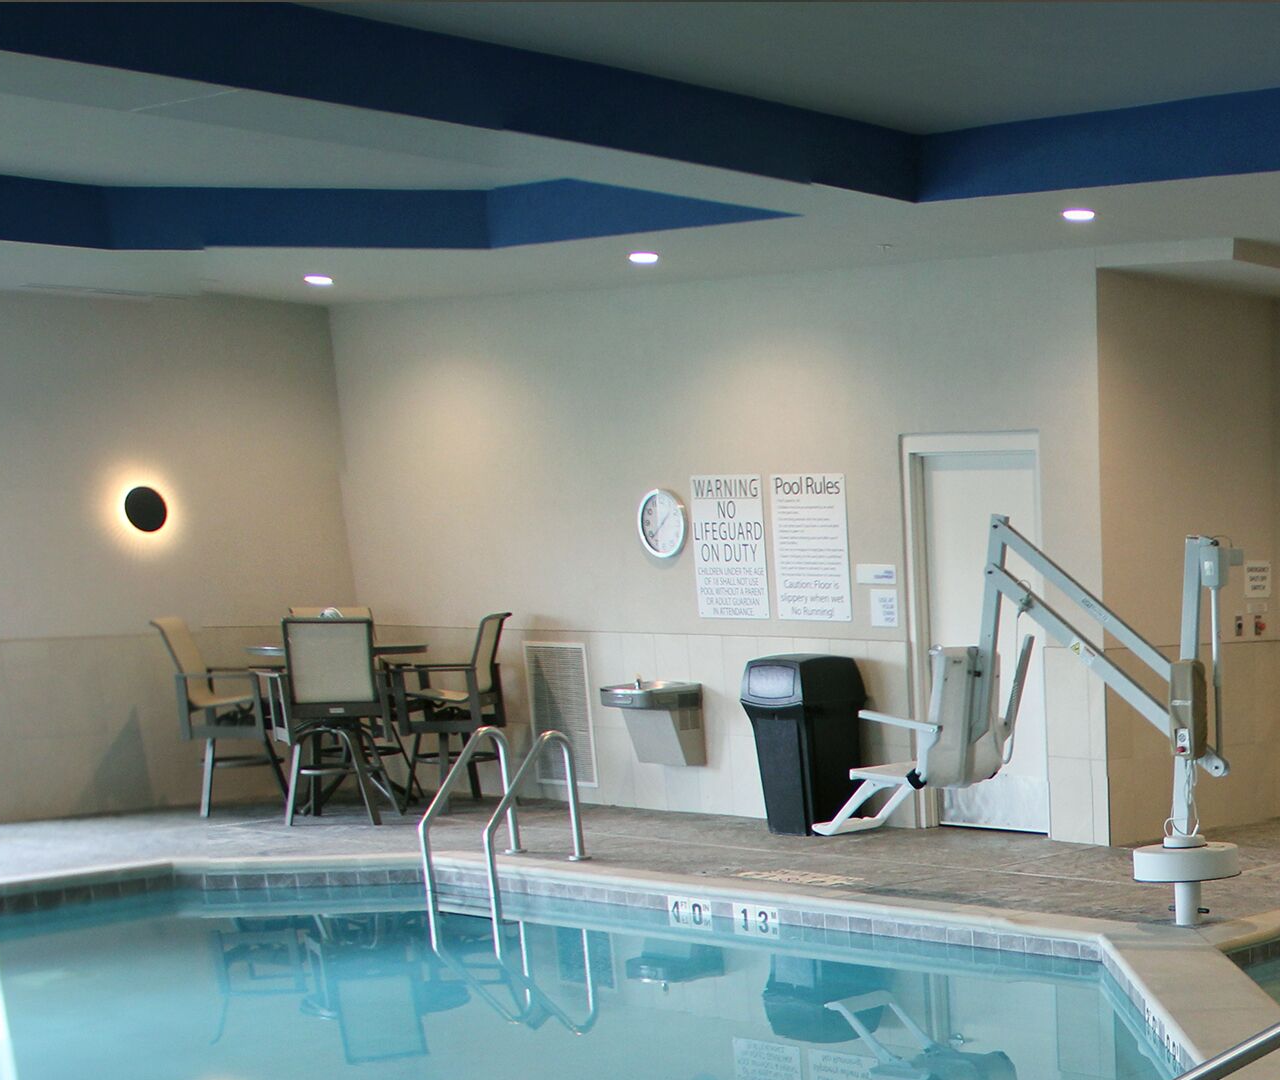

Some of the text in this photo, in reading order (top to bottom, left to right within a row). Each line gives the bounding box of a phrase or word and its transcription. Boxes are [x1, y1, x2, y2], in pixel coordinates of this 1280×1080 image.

[693, 478, 759, 498] WARNING
[774, 475, 841, 495] Pool Rules
[717, 500, 736, 519] NO
[694, 522, 763, 541] LIFEGUARD
[701, 543, 758, 562] ON DUTY
